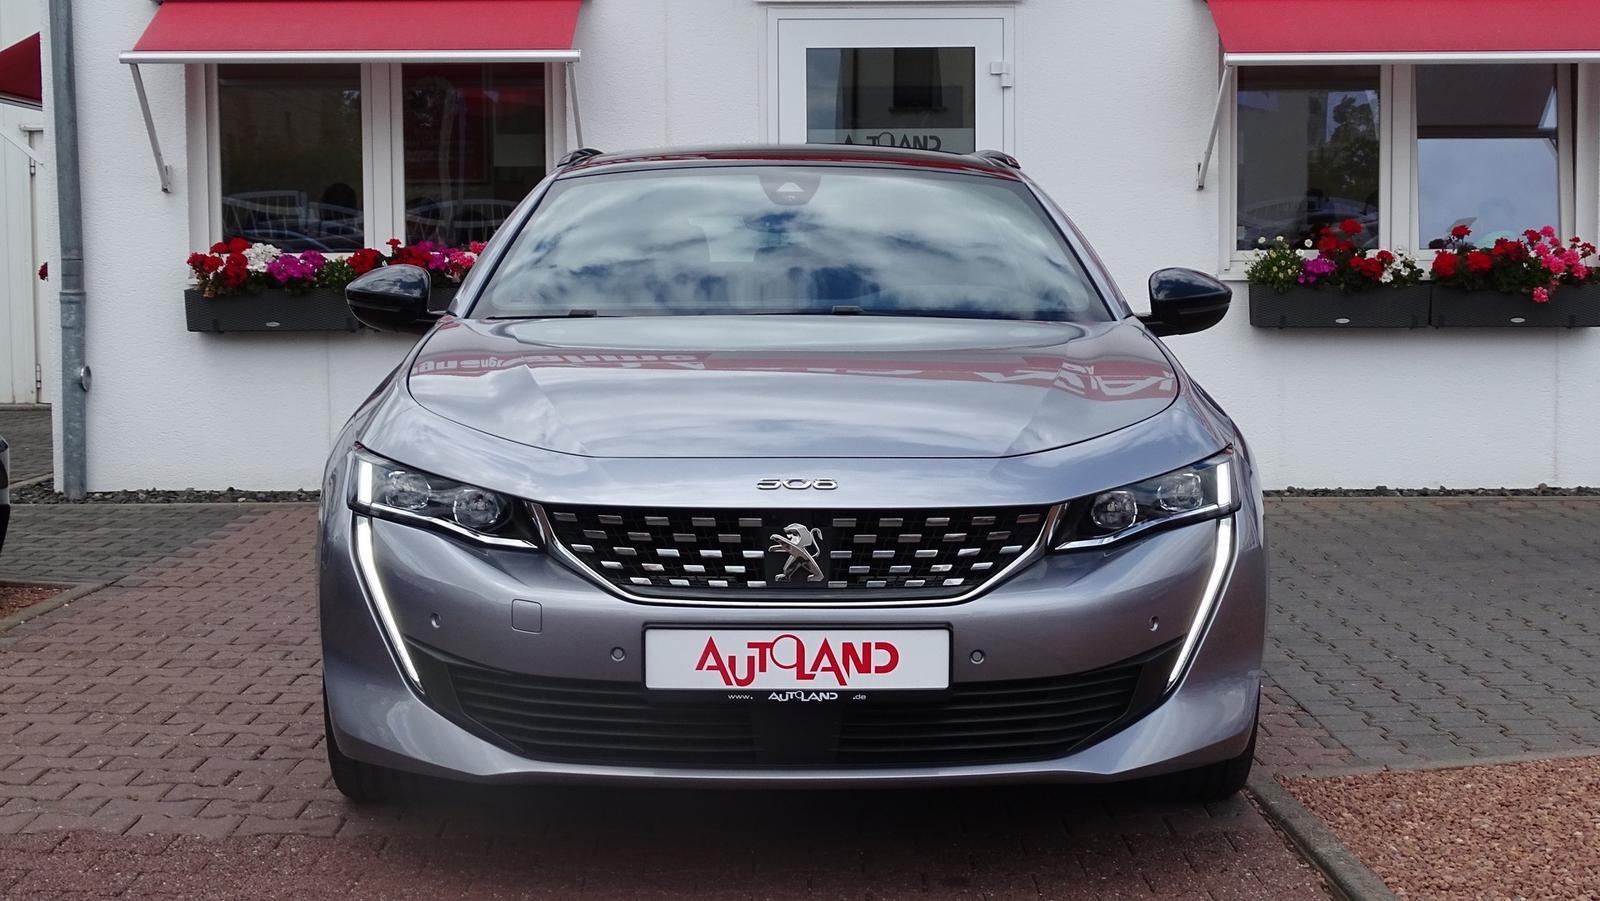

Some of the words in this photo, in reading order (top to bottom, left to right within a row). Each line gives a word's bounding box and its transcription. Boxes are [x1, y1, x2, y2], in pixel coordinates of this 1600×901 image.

[756, 478, 838, 490] 508
[695, 633, 899, 687] AUTOLAND
[768, 690, 838, 702] AUTOLAND
